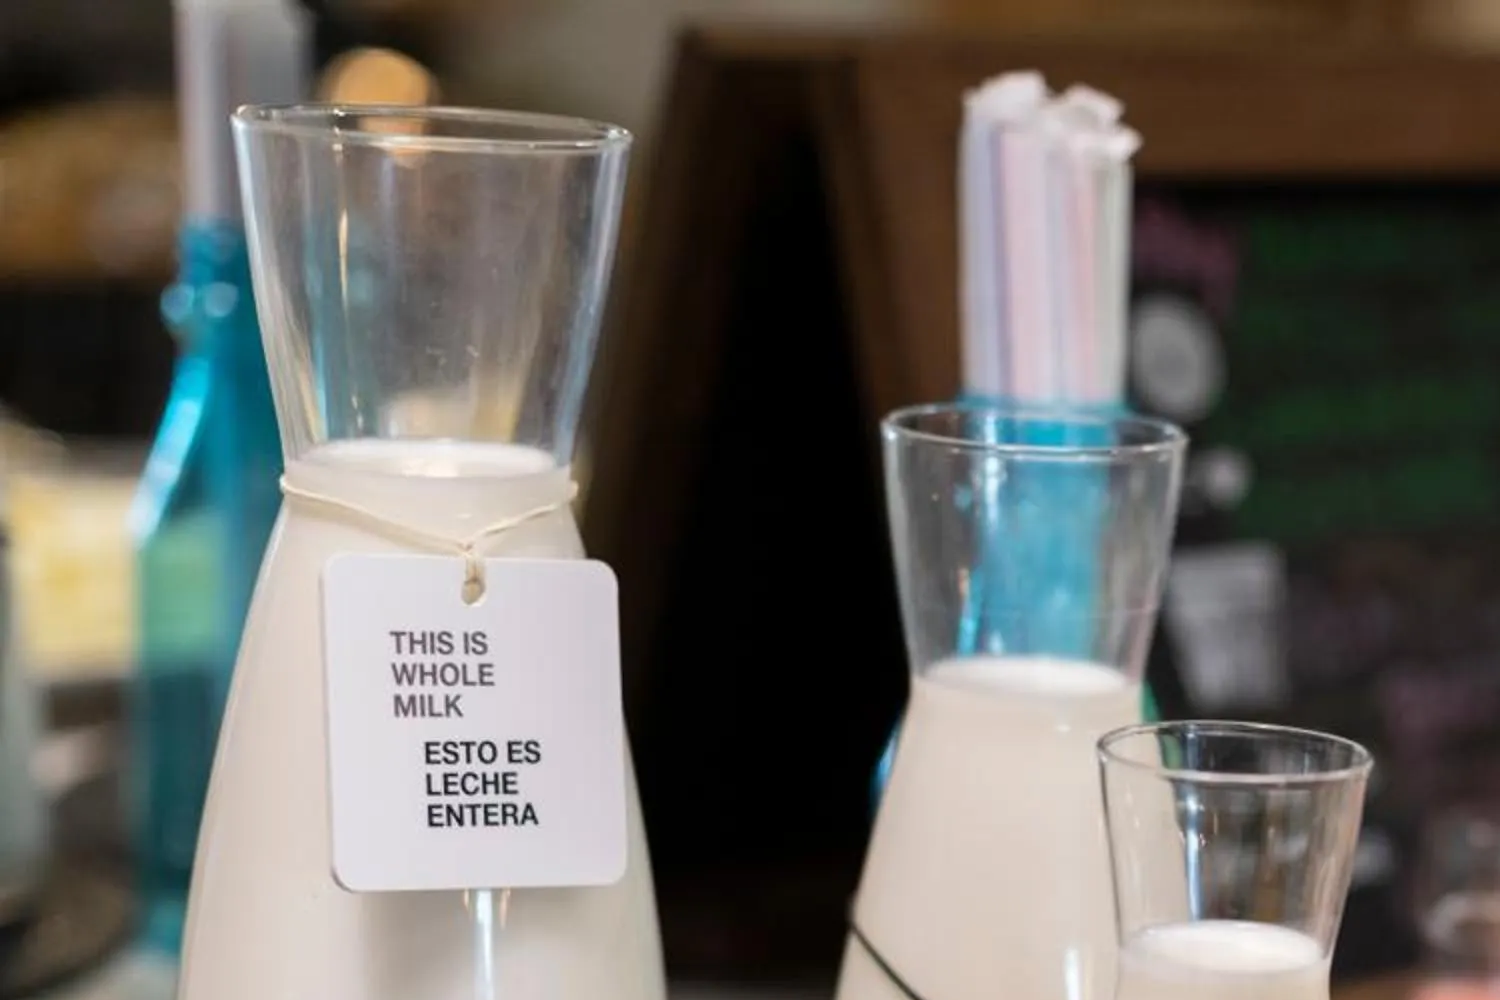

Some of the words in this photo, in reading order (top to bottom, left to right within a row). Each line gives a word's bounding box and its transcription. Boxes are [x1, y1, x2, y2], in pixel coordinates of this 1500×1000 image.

[390, 631, 455, 655] THIS
[464, 631, 489, 655] IS
[391, 663, 495, 686] WHOLE
[393, 694, 464, 718] MILK
[424, 741, 498, 765] ESTO
[507, 740, 542, 764] ES
[426, 772, 519, 796] LECHE
[427, 803, 539, 827] ENTERA
